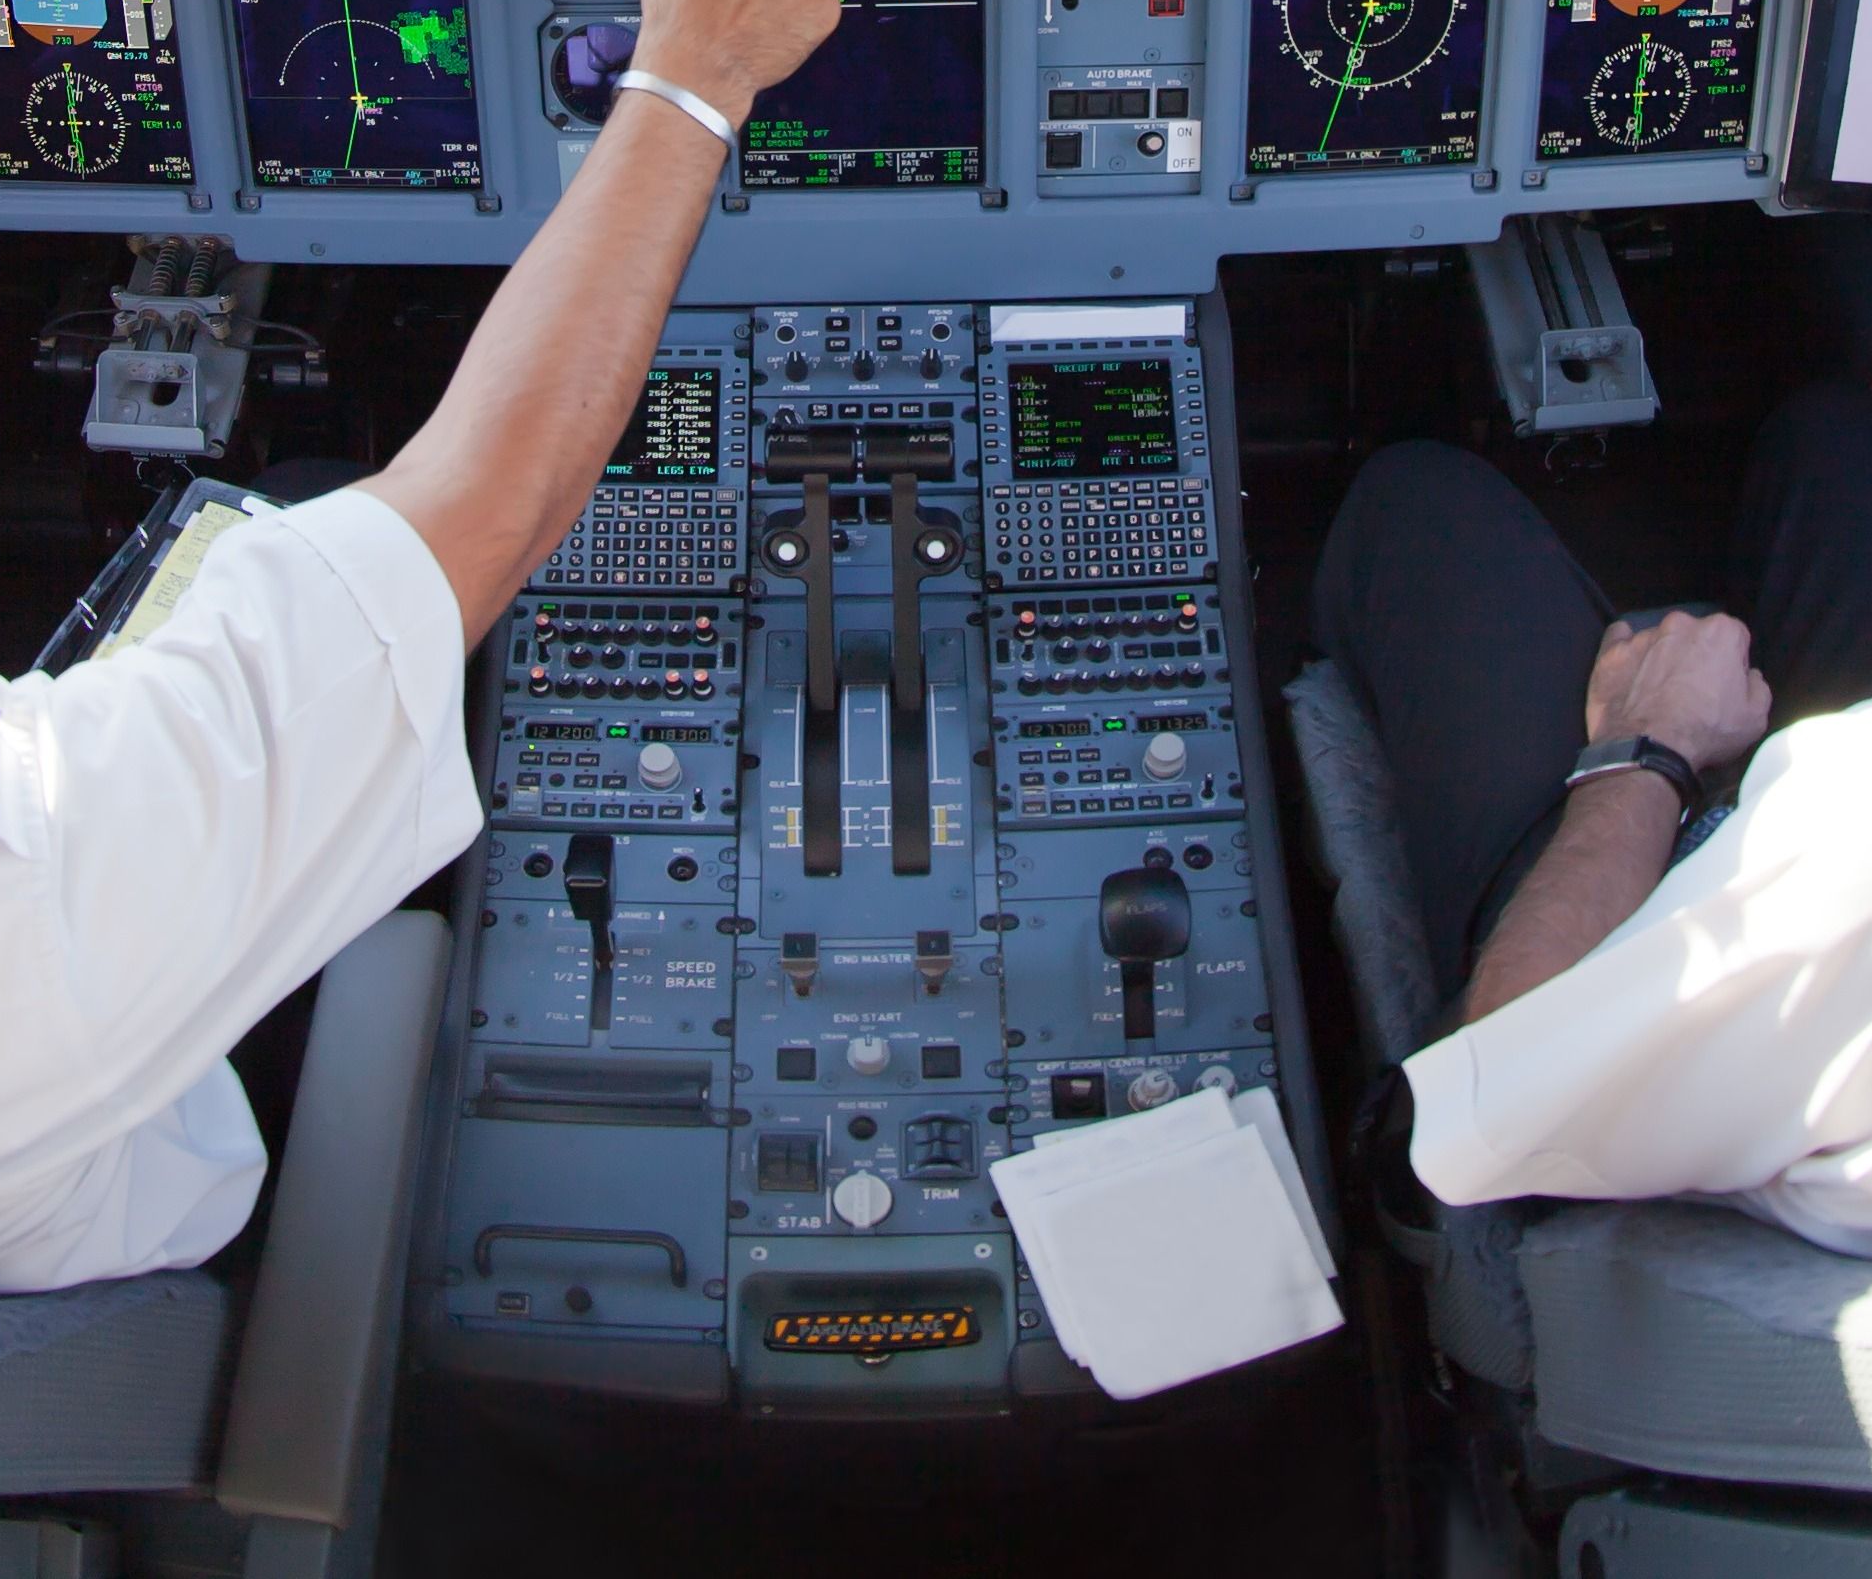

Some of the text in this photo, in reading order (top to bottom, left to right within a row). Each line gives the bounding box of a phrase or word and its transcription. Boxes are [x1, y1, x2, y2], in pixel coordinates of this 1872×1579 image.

[1640, 7, 1657, 15] 730
[56, 36, 72, 44] 730
[135, 74, 156, 82] FMS1
[1087, 69, 1152, 79] AUTO BRAKE
[1707, 85, 1746, 94] TERM 1.0
[1461, 111, 1476, 119] OFF
[142, 121, 181, 129] TERM 1.0
[771, 130, 808, 138] WEATHER
[1177, 128, 1192, 137] ON
[442, 144, 462, 152] TERR
[1360, 151, 1381, 159] ONLY
[1173, 159, 1195, 168] OFF
[364, 170, 385, 178] ONLY
[772, 176, 799, 184] WEIGHT
[1054, 364, 1097, 372] TAKEOFF
[1103, 363, 1122, 371] REF
[648, 372, 668, 380] EGS
[1141, 456, 1167, 464] LEGS
[658, 466, 710, 474] LEGS ETA
[1127, 904, 1168, 914] FLAPS
[834, 954, 911, 964] ENG MASTER
[667, 962, 716, 973] SPEED
[1196, 961, 1246, 974] FLAPS
[554, 973, 572, 981] 1/2
[665, 978, 717, 988] BRAKE
[834, 1012, 902, 1023] ENG START
[922, 1188, 959, 1200] TRIM
[778, 1217, 822, 1228] STAB
